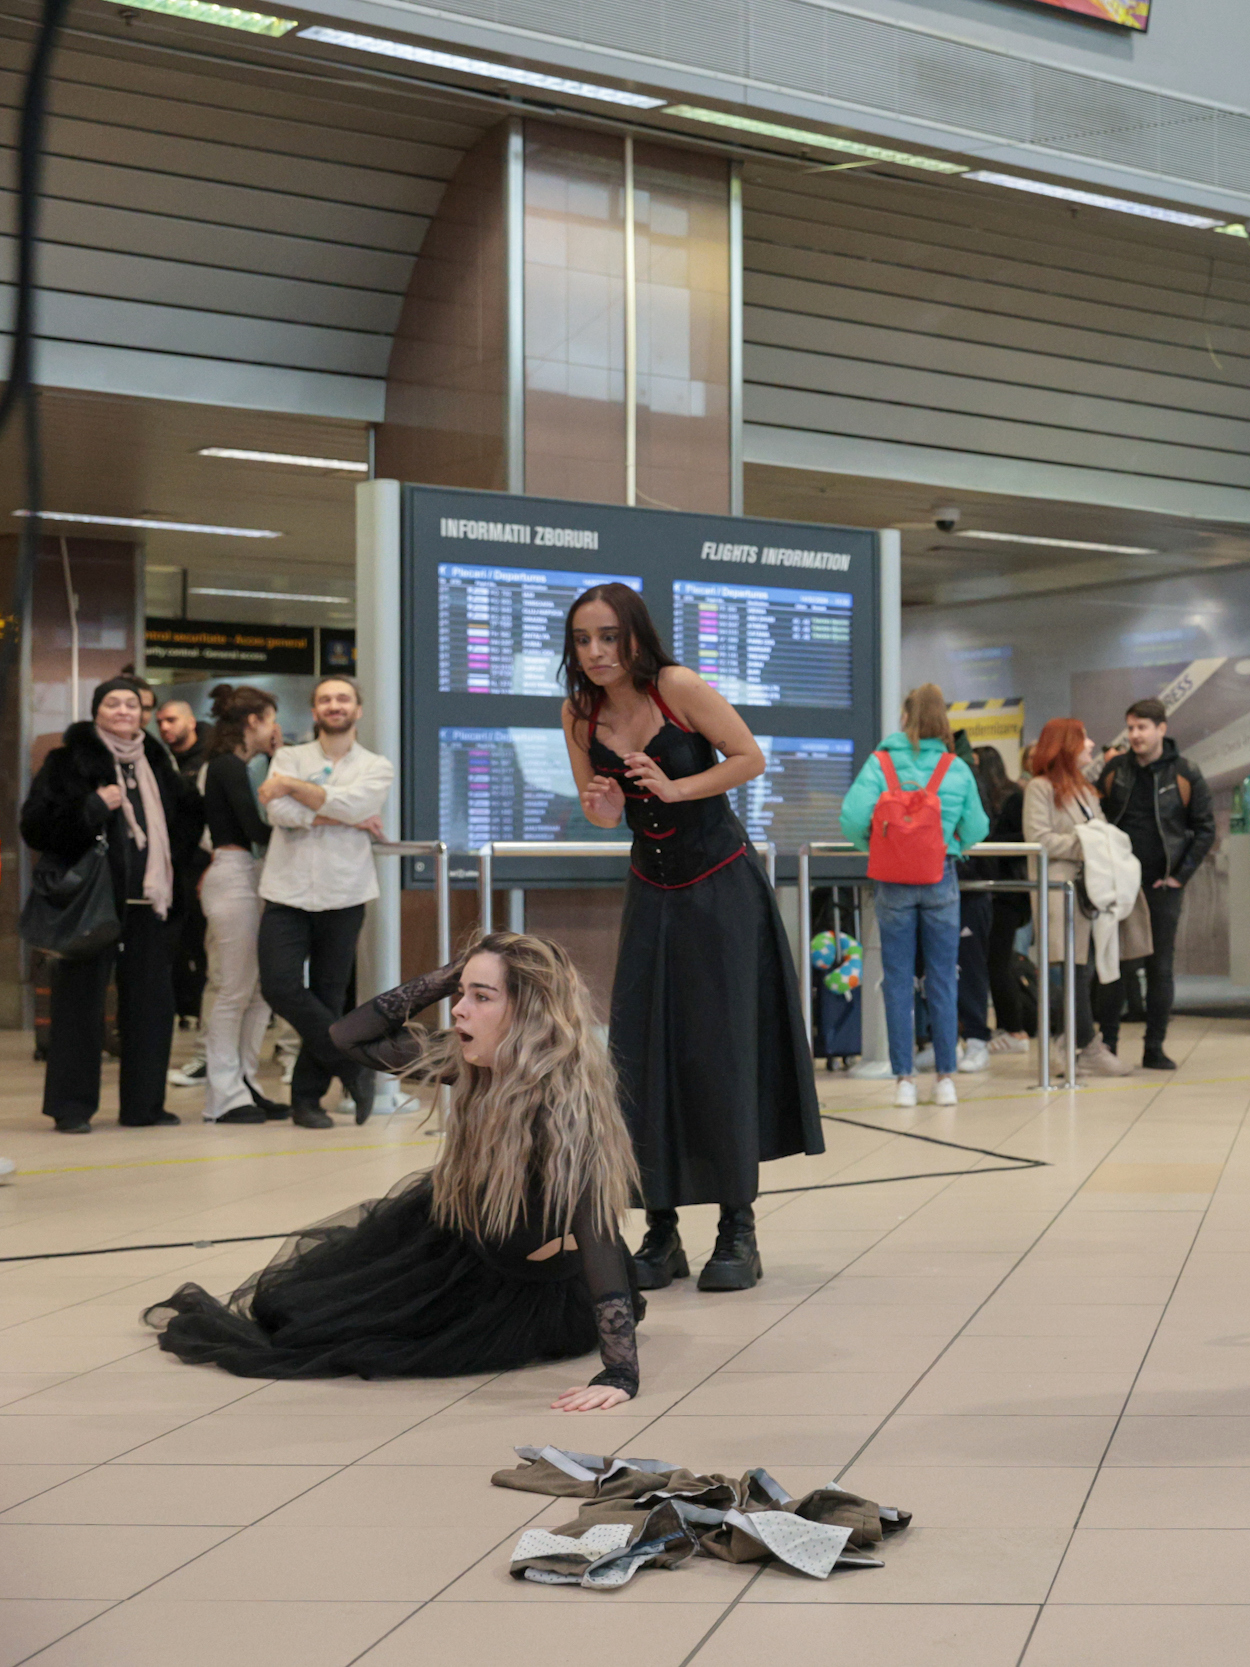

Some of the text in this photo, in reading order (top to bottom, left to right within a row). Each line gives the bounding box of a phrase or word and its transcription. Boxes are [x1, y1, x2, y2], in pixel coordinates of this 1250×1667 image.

[440, 517, 599, 551] INFORMATII ZBORURI
[701, 541, 852, 573] FLIGHTS INFORMATION
[493, 570, 547, 584] Departures
[722, 587, 769, 600] Departures
[145, 629, 171, 642] ntrol
